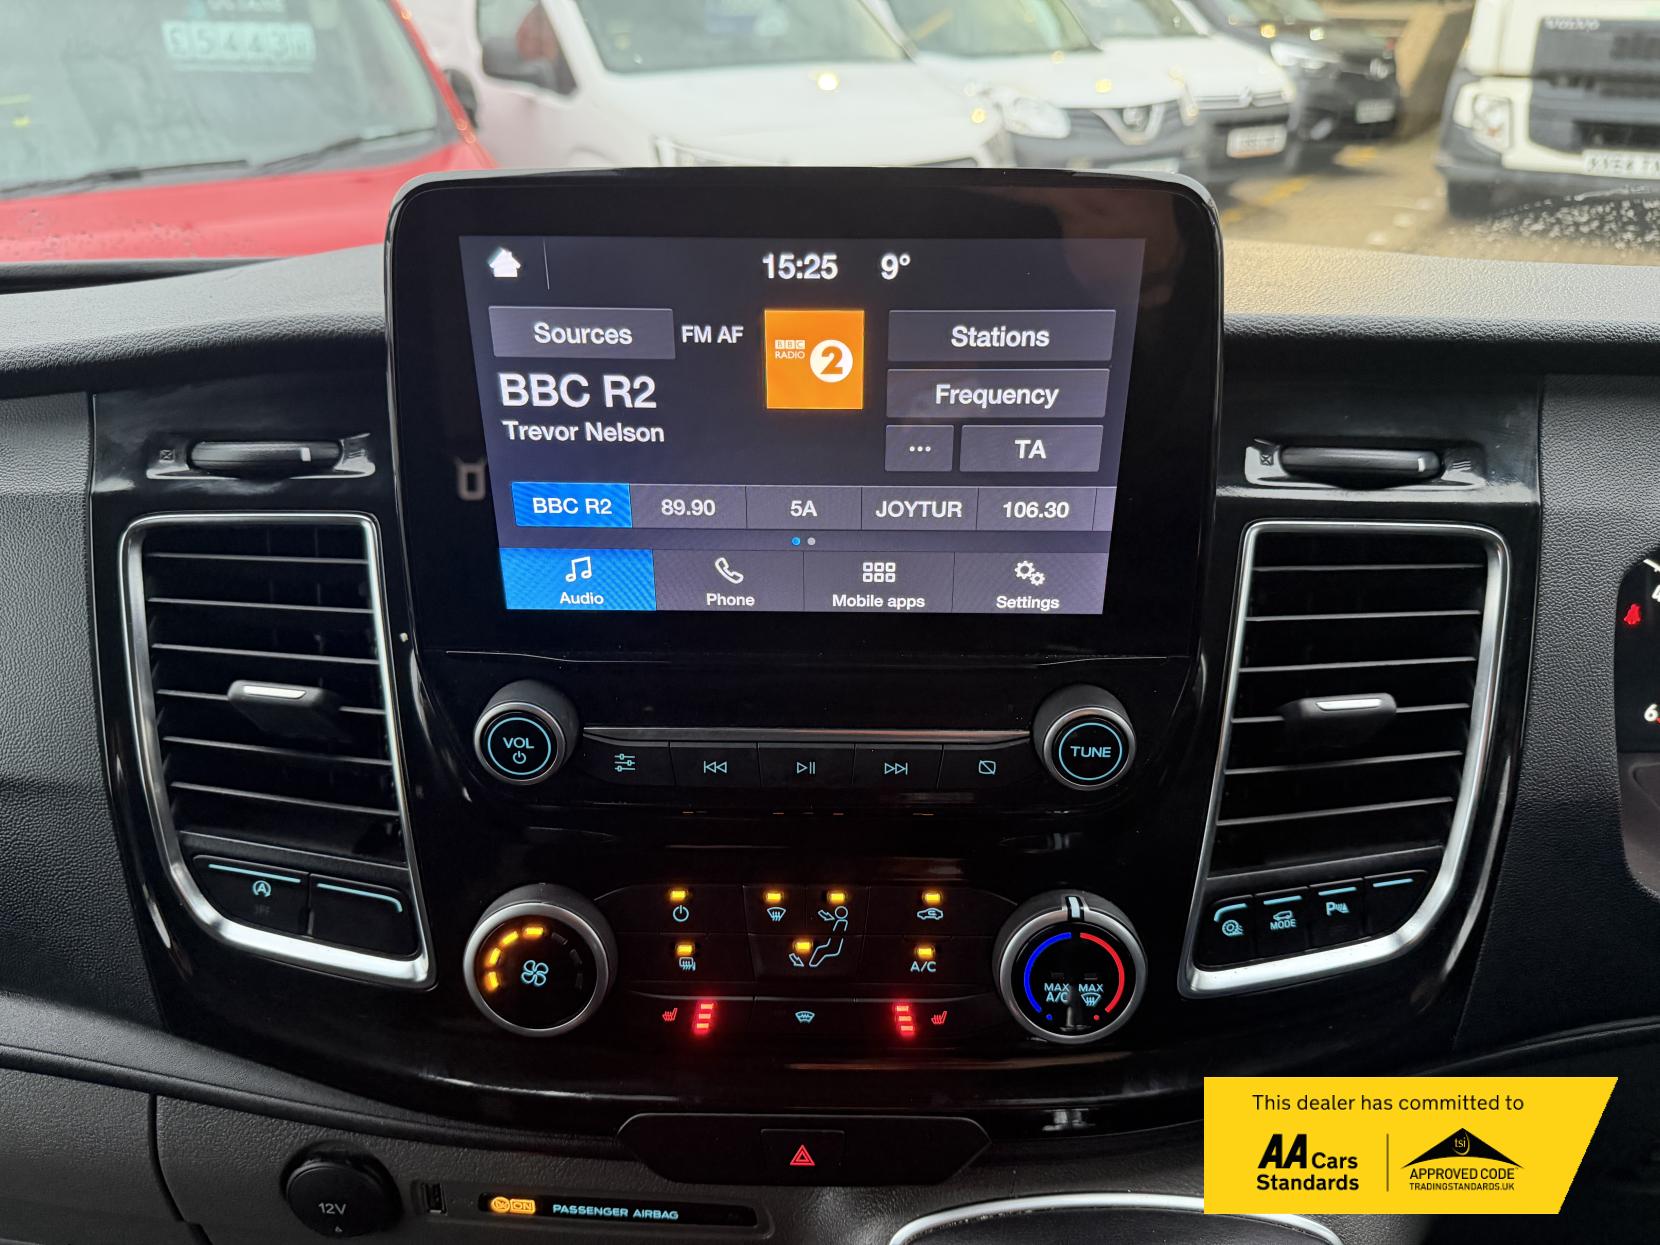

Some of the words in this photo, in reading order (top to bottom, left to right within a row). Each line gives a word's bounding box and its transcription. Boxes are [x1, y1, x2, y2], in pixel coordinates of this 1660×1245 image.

[762, 253, 839, 280] 15:25
[534, 322, 633, 345] Sources
[681, 326, 712, 343] FM
[716, 326, 744, 344] AF
[951, 326, 1050, 348] Stations
[775, 340, 806, 350] BBC
[775, 351, 806, 360] RADIO
[820, 345, 844, 375] 2
[498, 373, 591, 408] BBC
[603, 375, 657, 409] R2
[935, 383, 1059, 409] Frequency
[502, 420, 579, 441] Trevor
[586, 422, 665, 443] Nelson
[1014, 439, 1047, 459] TA
[532, 497, 578, 515] BBC
[585, 498, 613, 516] R2
[660, 499, 716, 516] 89.90
[789, 500, 818, 518] 5A
[875, 501, 963, 519] JOYTUR
[1002, 501, 1070, 519] 106.30
[559, 592, 604, 606] Audio
[706, 593, 755, 607] Phone
[832, 594, 884, 608] Mobile
[888, 596, 926, 610] apps
[996, 596, 1060, 612] Settings
[503, 737, 534, 750] VOL
[1070, 746, 1112, 759] TUNE
[1270, 918, 1297, 931] MODE
[910, 961, 937, 973] A/C
[1044, 982, 1070, 991] MAX
[1078, 983, 1105, 992] MAX
[318, 1202, 347, 1215] 12V
[552, 1204, 628, 1218] PASSENGER
[633, 1208, 679, 1220] AIRBAG
